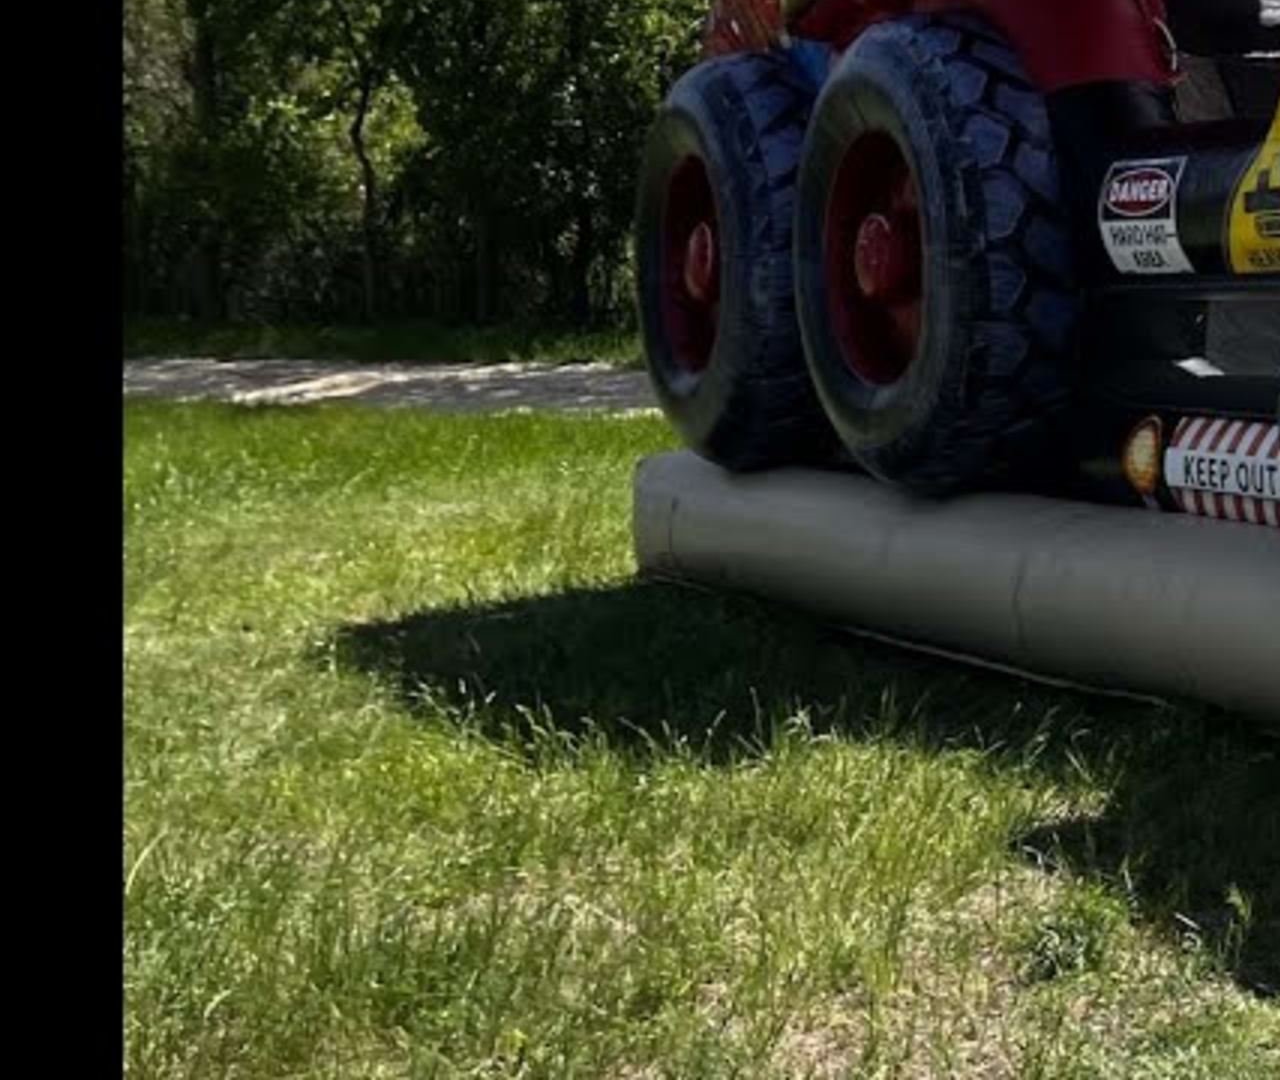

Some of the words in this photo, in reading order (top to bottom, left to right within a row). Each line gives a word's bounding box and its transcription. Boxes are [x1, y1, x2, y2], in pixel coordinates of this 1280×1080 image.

[1108, 179, 1169, 202] DANGER
[1110, 224, 1144, 247] HARD
[1184, 456, 1230, 488] KEEP
[1236, 463, 1278, 496] OUT
